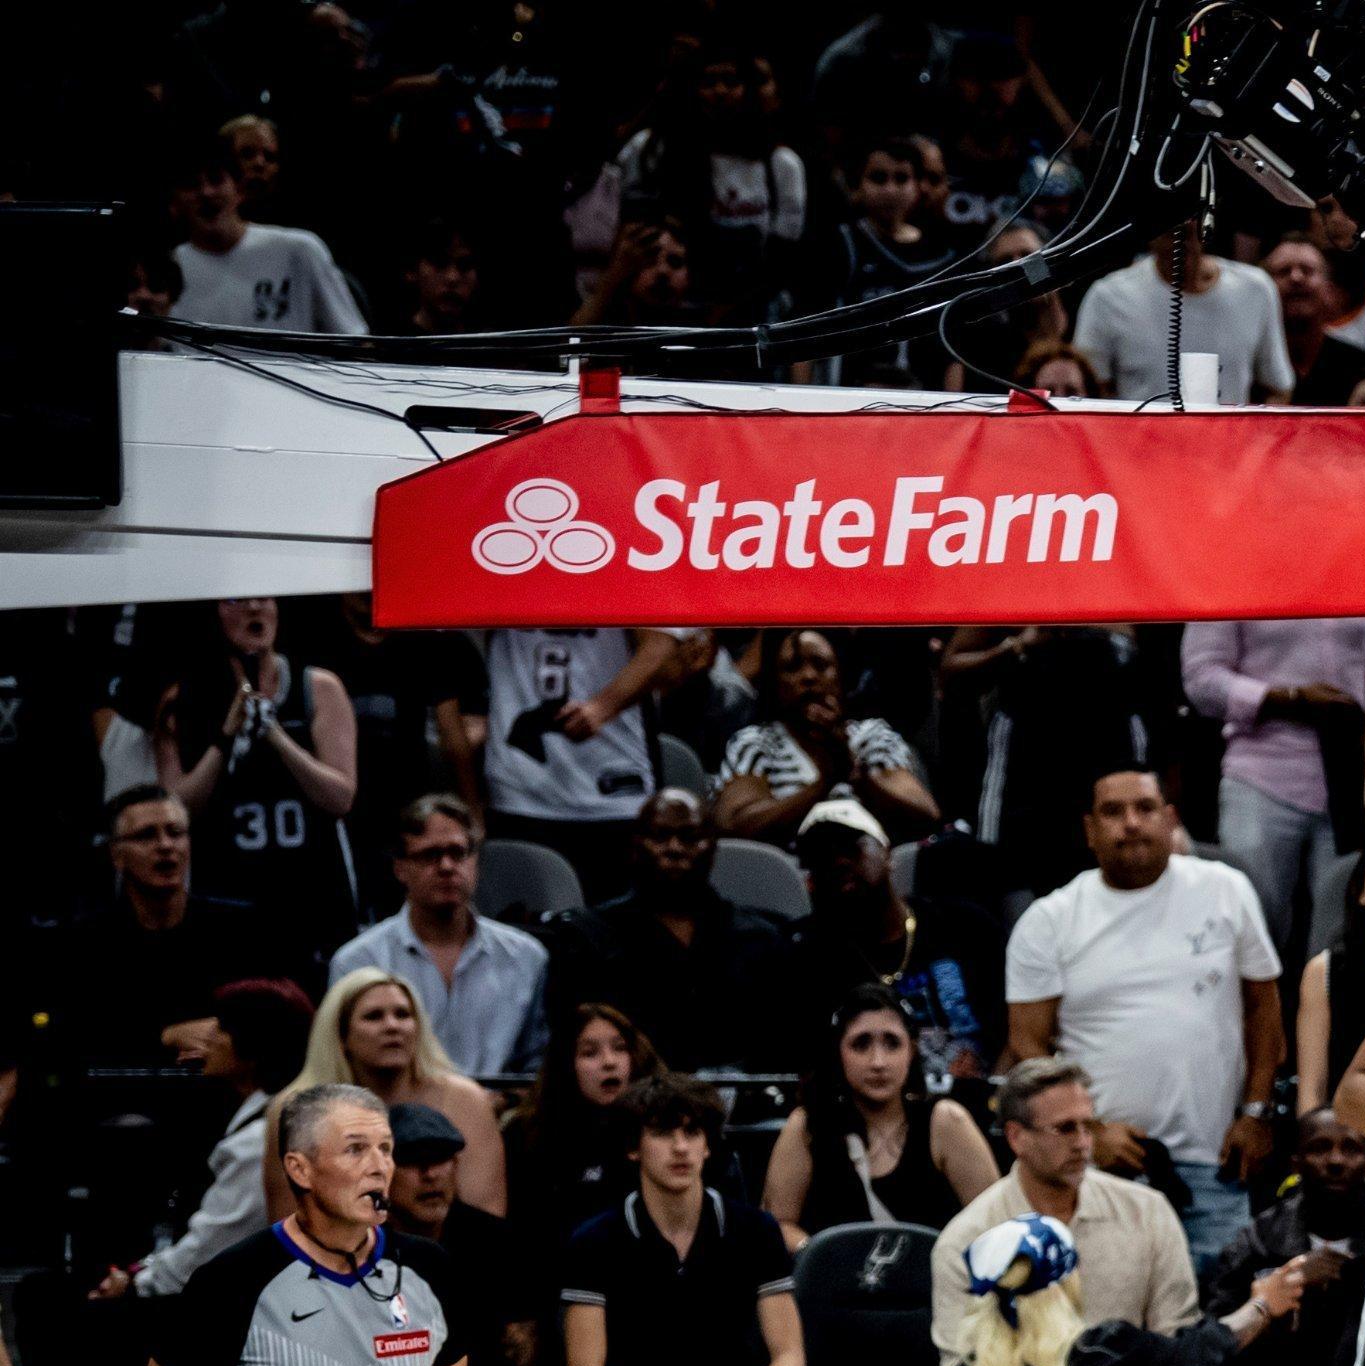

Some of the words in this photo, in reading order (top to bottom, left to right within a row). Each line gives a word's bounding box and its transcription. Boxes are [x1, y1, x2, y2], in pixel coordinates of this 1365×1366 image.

[627, 479, 875, 570] State
[883, 476, 1118, 567] Farm
[233, 802, 305, 850] 30
[375, 1336, 430, 1353] Emirates
